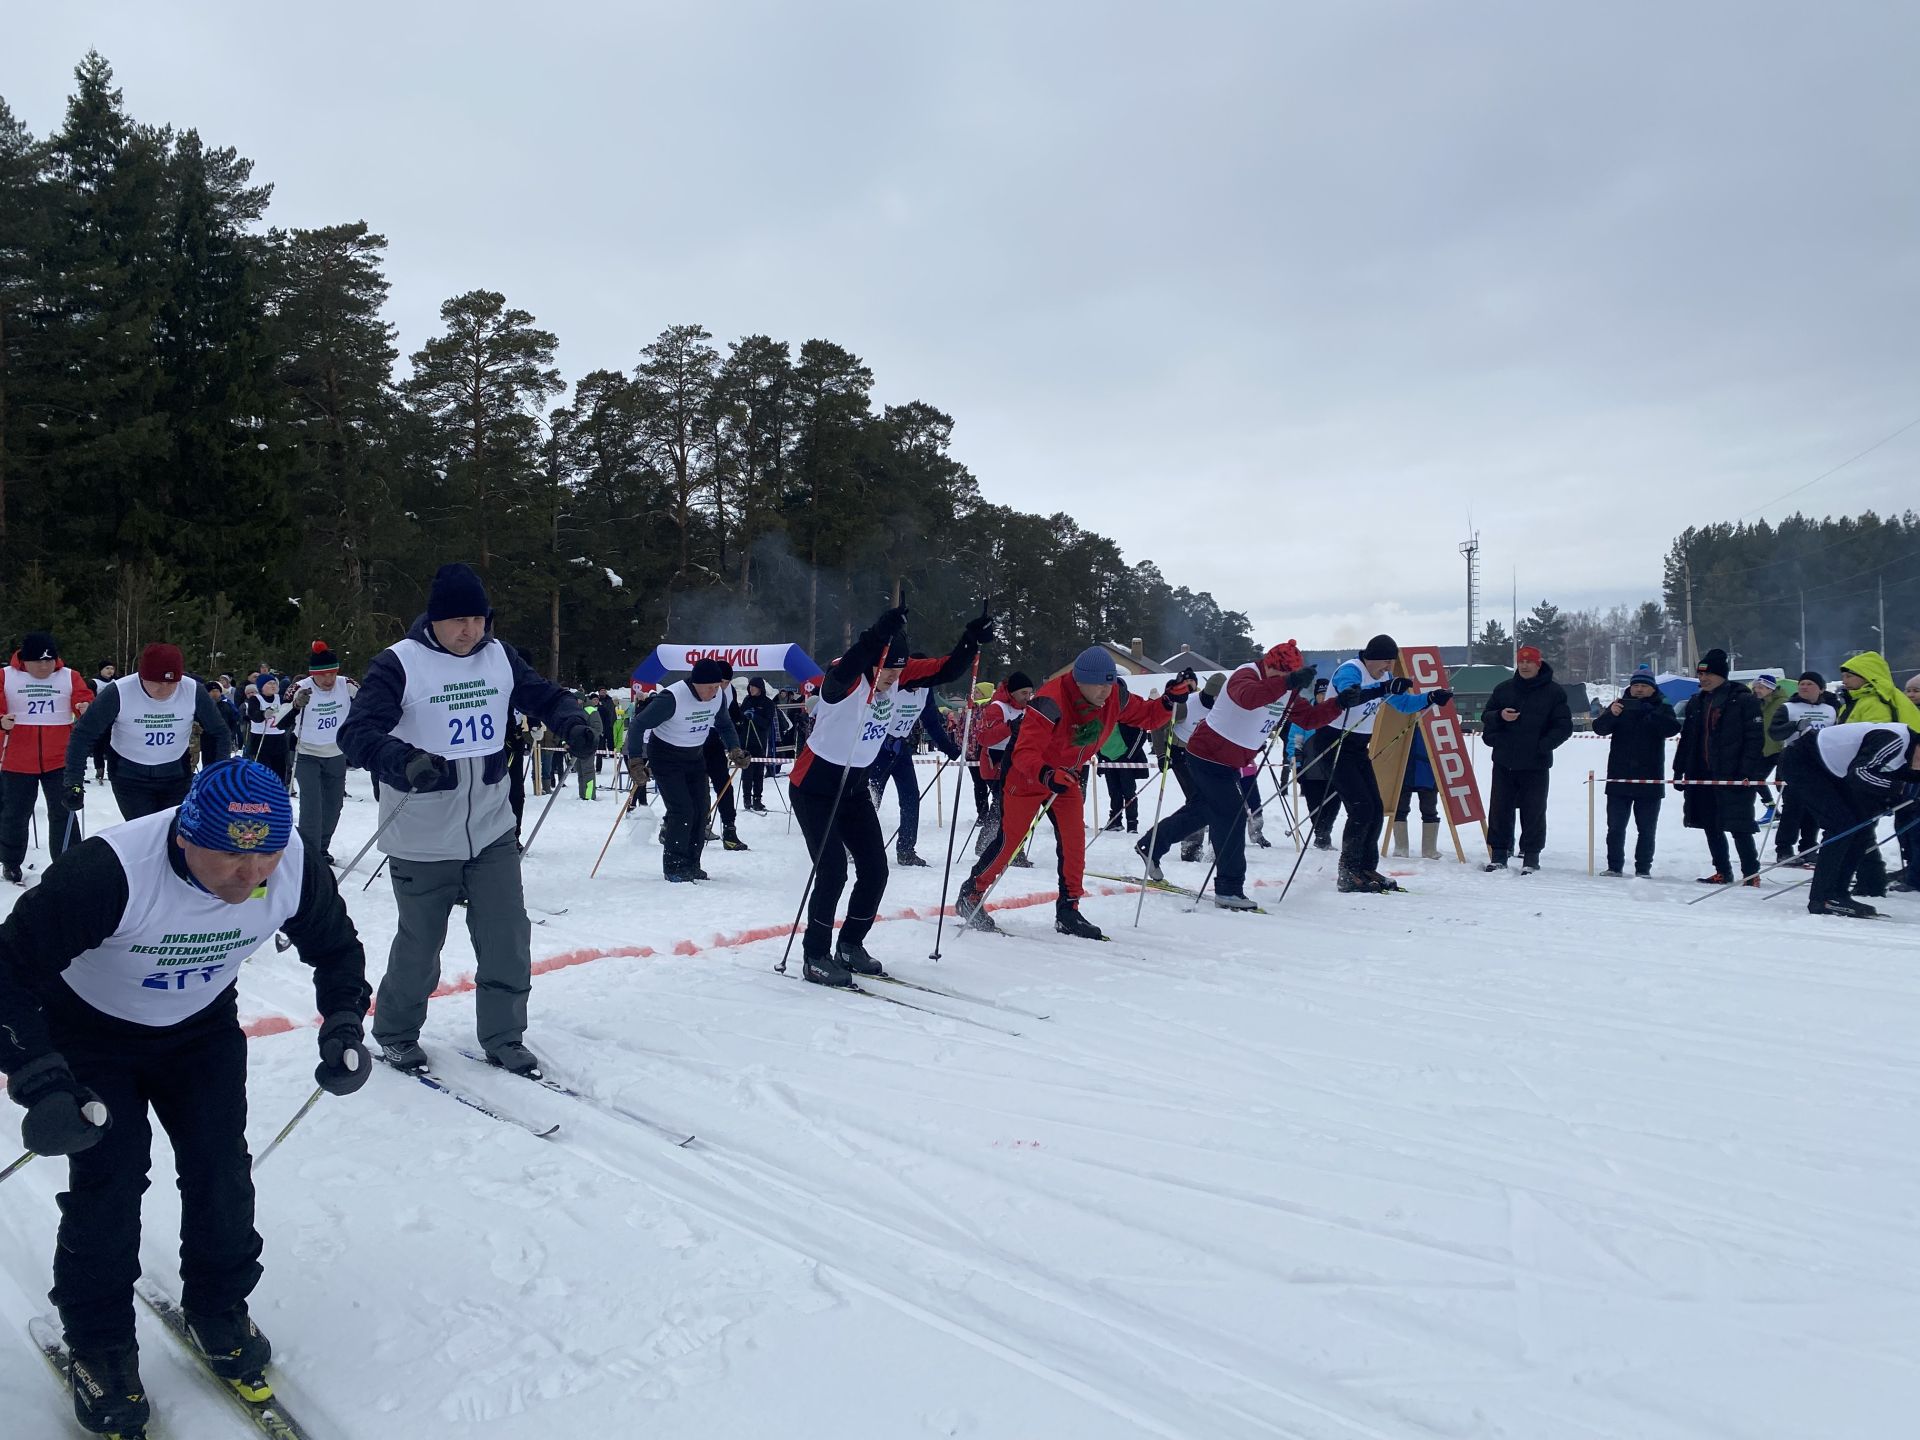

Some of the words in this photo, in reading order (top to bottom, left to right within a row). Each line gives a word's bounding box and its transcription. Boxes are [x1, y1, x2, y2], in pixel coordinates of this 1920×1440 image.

[685, 648, 759, 667] ФИНИШ
[443, 679, 486, 692] ЛУБЯНСКИЙ
[429, 687, 499, 704] ЛЕСОТЕХНИЧЕСКИЙ
[27, 700, 55, 715] 271
[448, 699, 488, 711] КОЛЛЕДЖ
[317, 716, 338, 730] 260
[448, 714, 495, 745] 218
[145, 732, 176, 746] 202
[228, 802, 272, 814] RUSSIA
[160, 928, 242, 944] ЛУБЯНСКИЙ
[156, 953, 228, 966] КОЛЛЕДЖ
[73, 1361, 104, 1399] FISCHER
